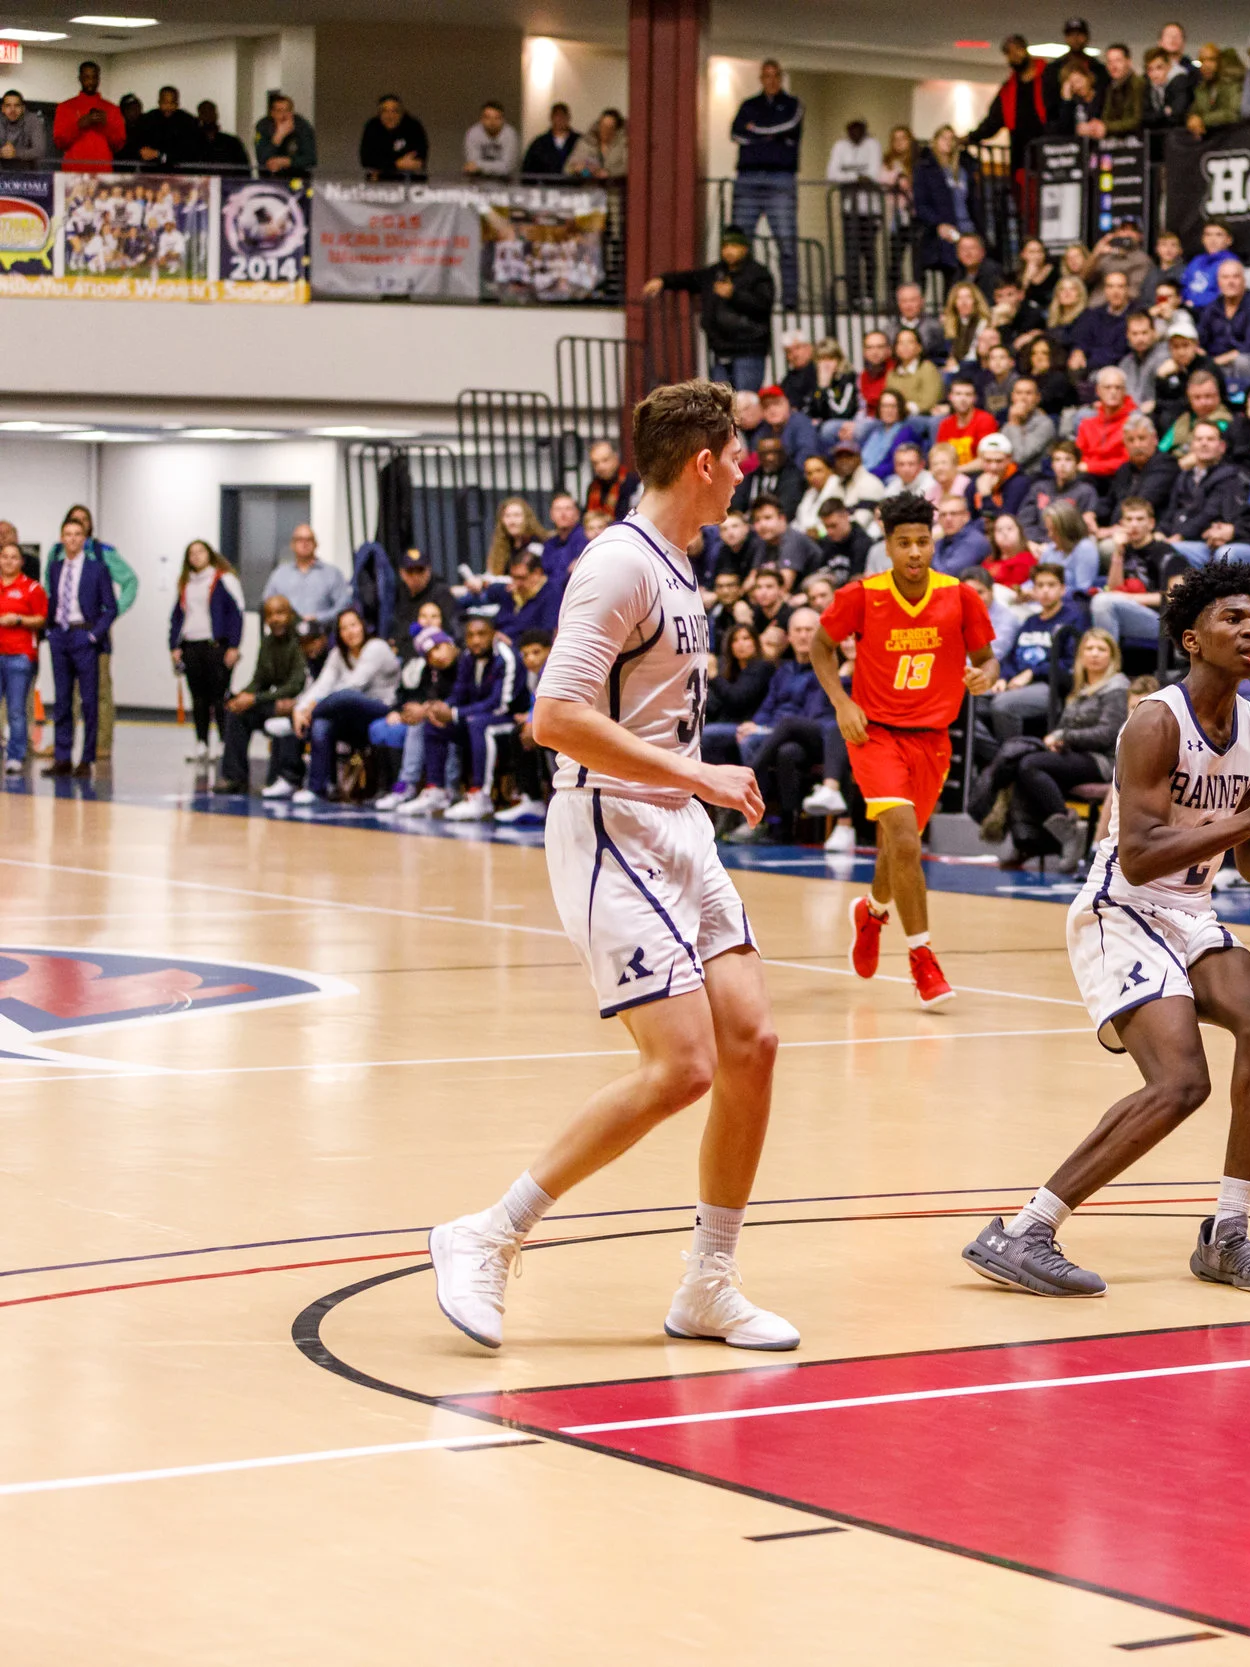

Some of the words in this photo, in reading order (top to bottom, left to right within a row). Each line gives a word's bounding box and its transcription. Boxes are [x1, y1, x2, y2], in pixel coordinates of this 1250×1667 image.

[229, 255, 298, 281] 2014
[890, 627, 938, 641] BERGEN
[884, 637, 943, 652] CATHOLIC
[893, 652, 936, 690] 13
